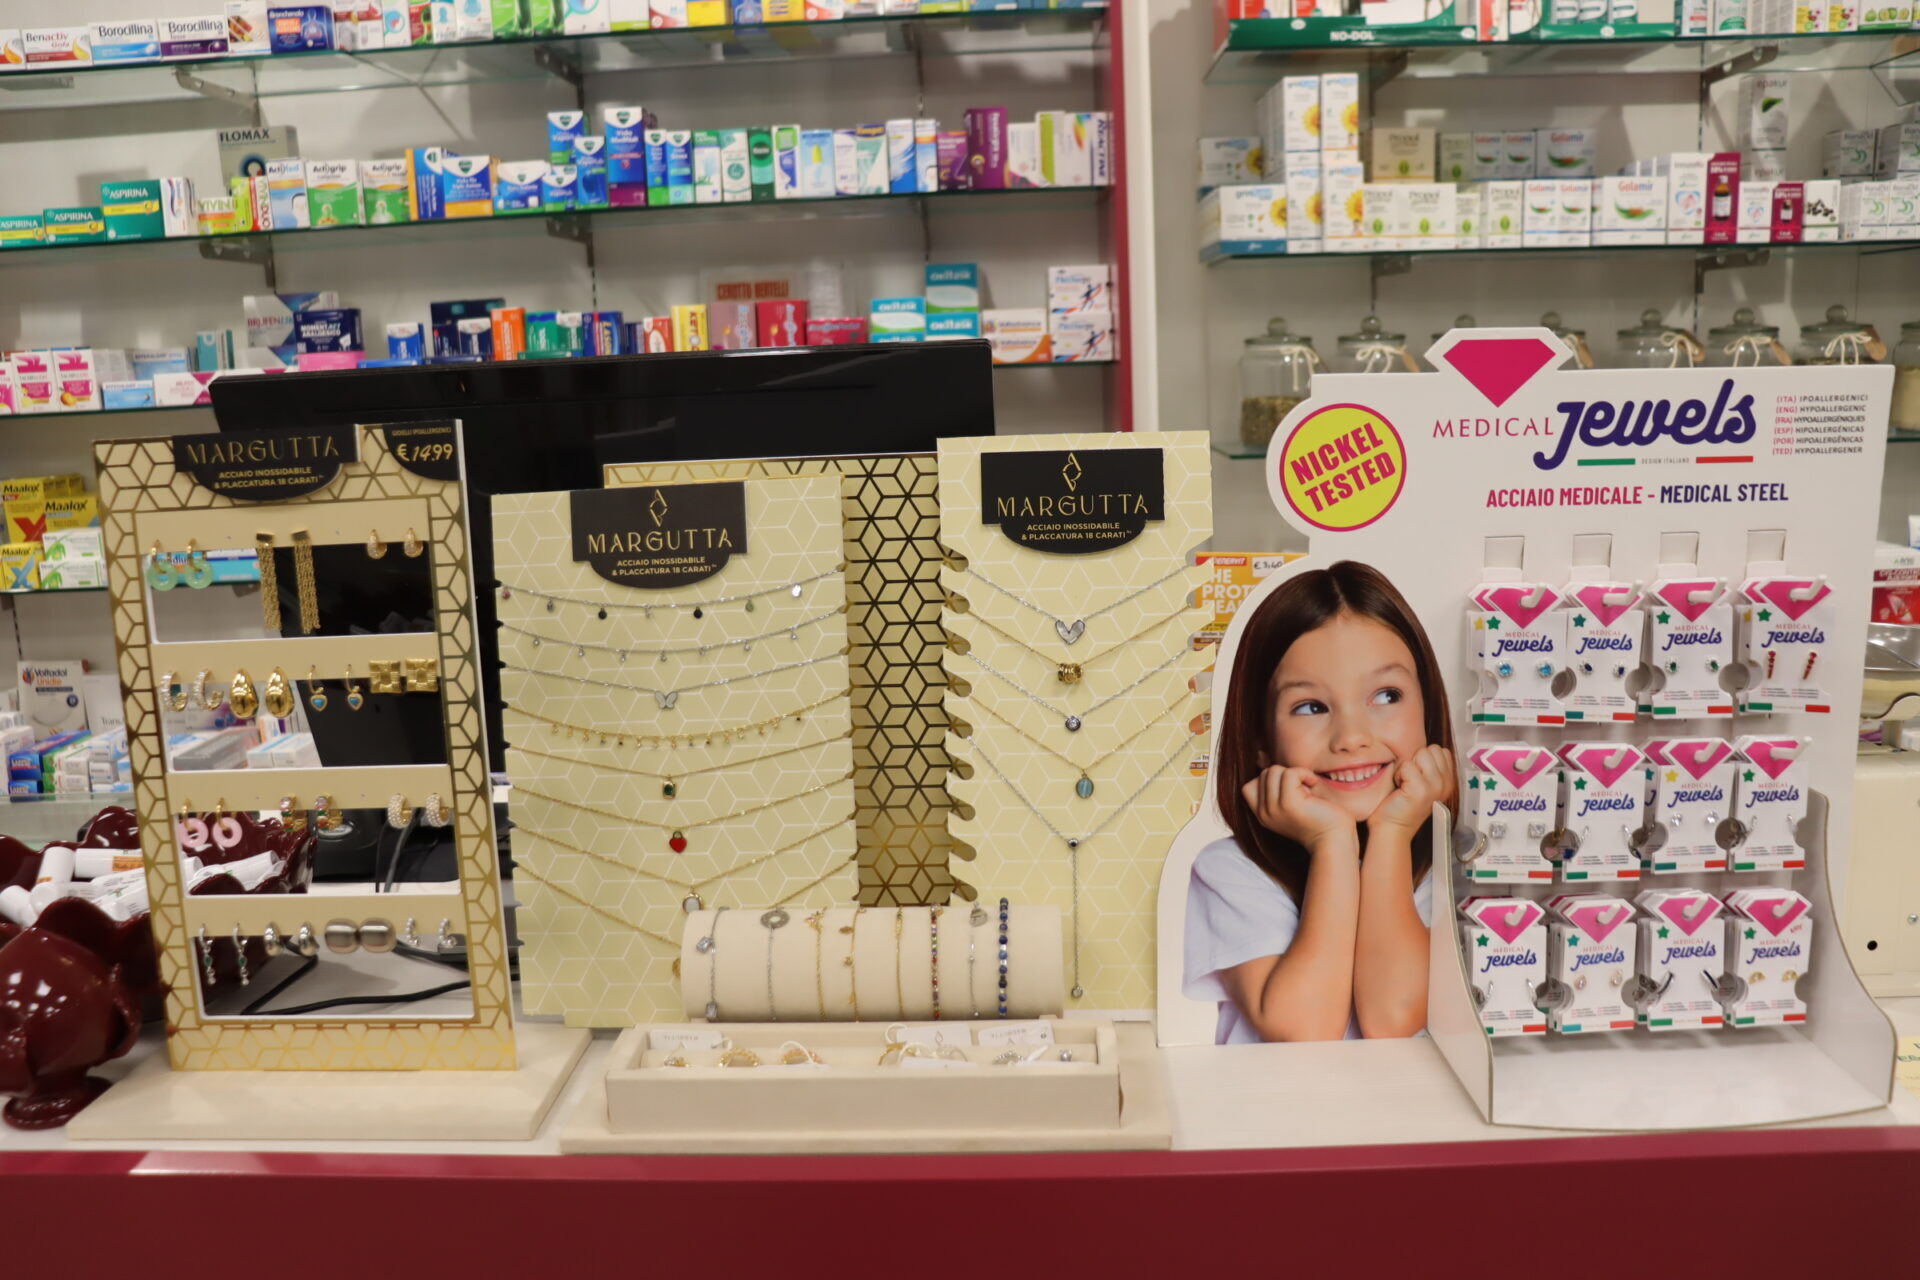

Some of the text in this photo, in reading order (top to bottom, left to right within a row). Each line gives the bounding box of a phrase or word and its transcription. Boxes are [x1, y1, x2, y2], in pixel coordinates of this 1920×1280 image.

[98, 23, 154, 37] Borocillina
[168, 19, 224, 34] Borocillina
[25, 30, 69, 43] Benactiv
[1330, 31, 1375, 41] NO-DOL
[219, 128, 270, 143] FLOMAX
[109, 187, 149, 200] ASPIRINA
[54, 211, 94, 222] ASPIRINA
[0, 218, 39, 229] ASPIRINA
[1776, 394, 1868, 404] (ITA) IPOALLERGENICI
[1776, 405, 1867, 413] (ENG) HYPOALLERGENIC
[1775, 416, 1793, 424] (FRA)
[1432, 417, 1553, 438] MEDICAL
[1774, 426, 1793, 435] (ESP)
[1773, 437, 1794, 445] (POR)
[187, 435, 341, 465] MARGUTTA
[397, 443, 410, 462] €
[1290, 422, 1383, 485] NICKEL
[1772, 447, 1793, 455] (TED)
[219, 466, 312, 480] ACCIAIO INOSSIDABILE
[222, 478, 276, 489] PLACCATURA
[288, 476, 319, 486] CARATI
[1304, 451, 1396, 512] TESTED
[3, 483, 40, 494] Maalox
[1486, 488, 1554, 508] ACCIAIO
[1560, 486, 1643, 506] MEDICALE
[1660, 484, 1732, 504] MEDICAL
[1738, 483, 1789, 502] STEEL
[45, 500, 88, 512] Maalox
[998, 493, 1149, 517] MARGUTTA
[1027, 522, 1120, 532] ACCIAIO INOSSIDABILE
[588, 528, 732, 554] MARGUTTA
[1029, 532, 1083, 541] PLACCATURA
[1095, 531, 1126, 539] CARATI
[2, 547, 31, 556] Maalox
[617, 556, 706, 567] ACCIAIO INOSSIDABILE
[619, 566, 671, 576] PLACCATURA
[672, 566, 681, 574] 18
[682, 565, 711, 573] CARATI
[1202, 584, 1257, 599] PROT
[34, 668, 68, 677] Voltadol
